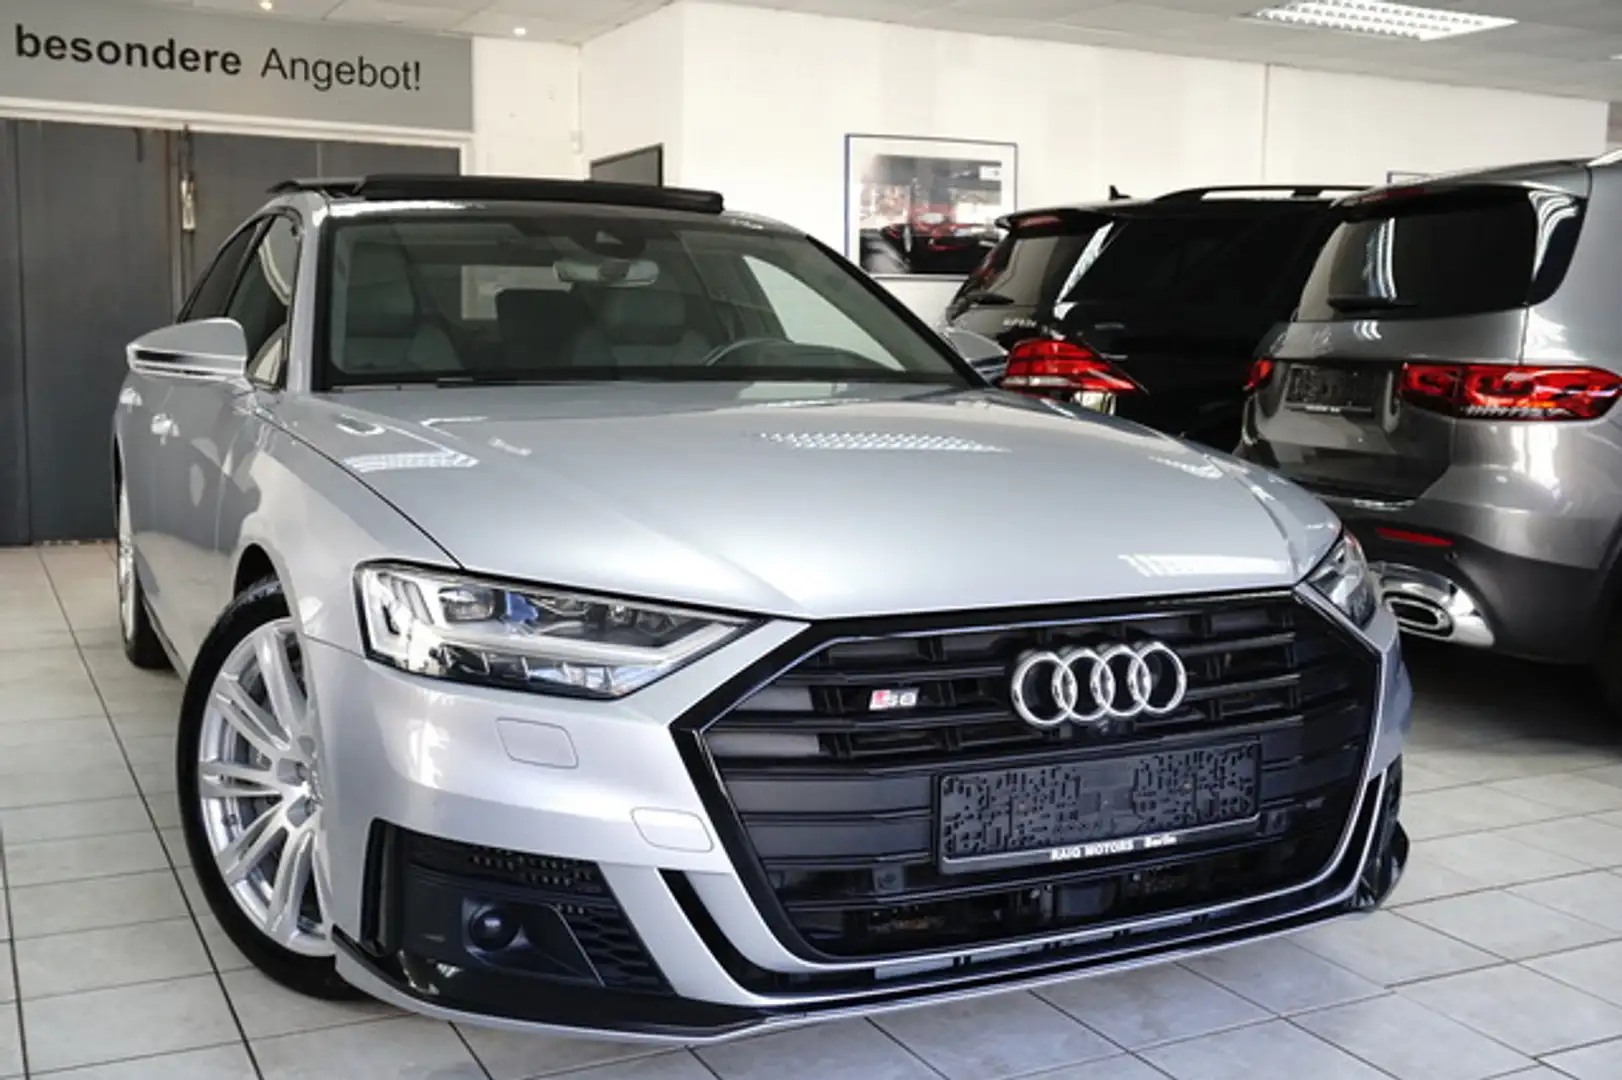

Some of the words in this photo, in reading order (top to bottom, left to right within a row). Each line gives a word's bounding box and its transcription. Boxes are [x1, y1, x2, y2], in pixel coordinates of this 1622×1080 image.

[15, 23, 242, 76] besondere
[260, 47, 421, 92] Angebot!
[1084, 840, 1134, 857] MOTORS
